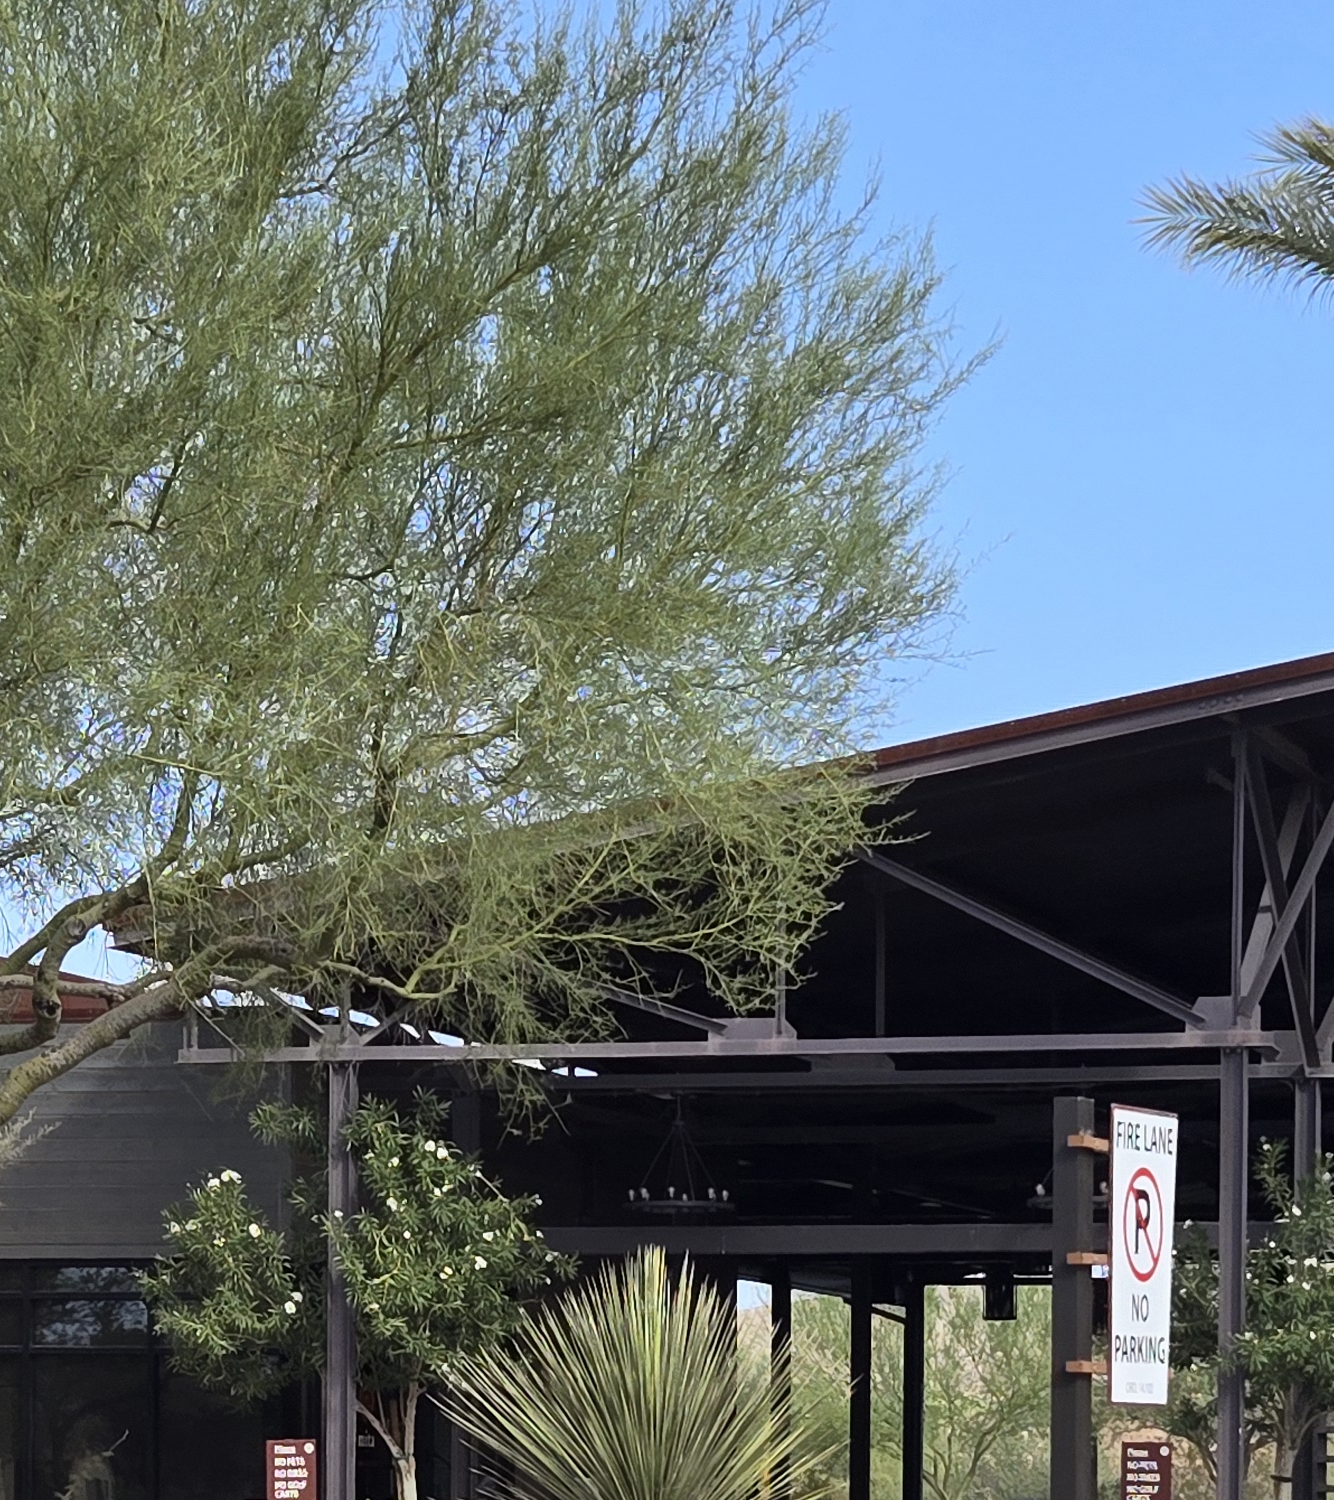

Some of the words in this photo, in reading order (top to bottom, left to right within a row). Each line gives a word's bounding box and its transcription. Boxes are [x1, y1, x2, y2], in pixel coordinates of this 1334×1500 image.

[1116, 1121, 1141, 1151] FIRE
[1143, 1124, 1173, 1156] LANE
[1131, 1293, 1150, 1323] NO
[1114, 1334, 1166, 1365] PARKING
